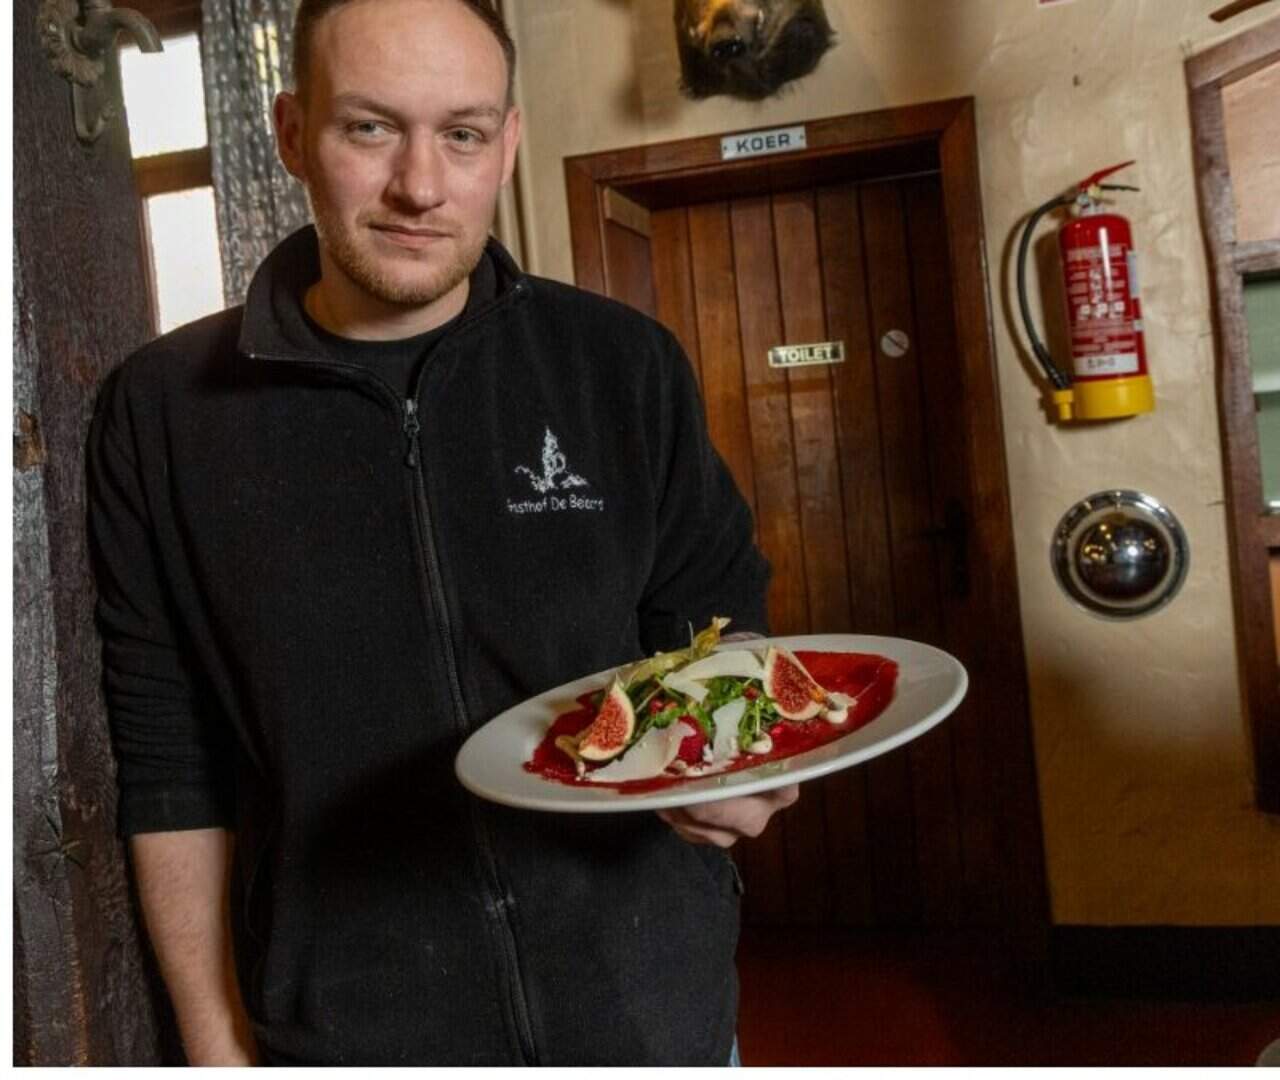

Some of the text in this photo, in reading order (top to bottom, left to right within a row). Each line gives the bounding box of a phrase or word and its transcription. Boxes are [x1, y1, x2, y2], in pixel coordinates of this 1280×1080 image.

[736, 133, 791, 153] KOER
[779, 346, 833, 363] TOILET
[550, 496, 568, 511] De
